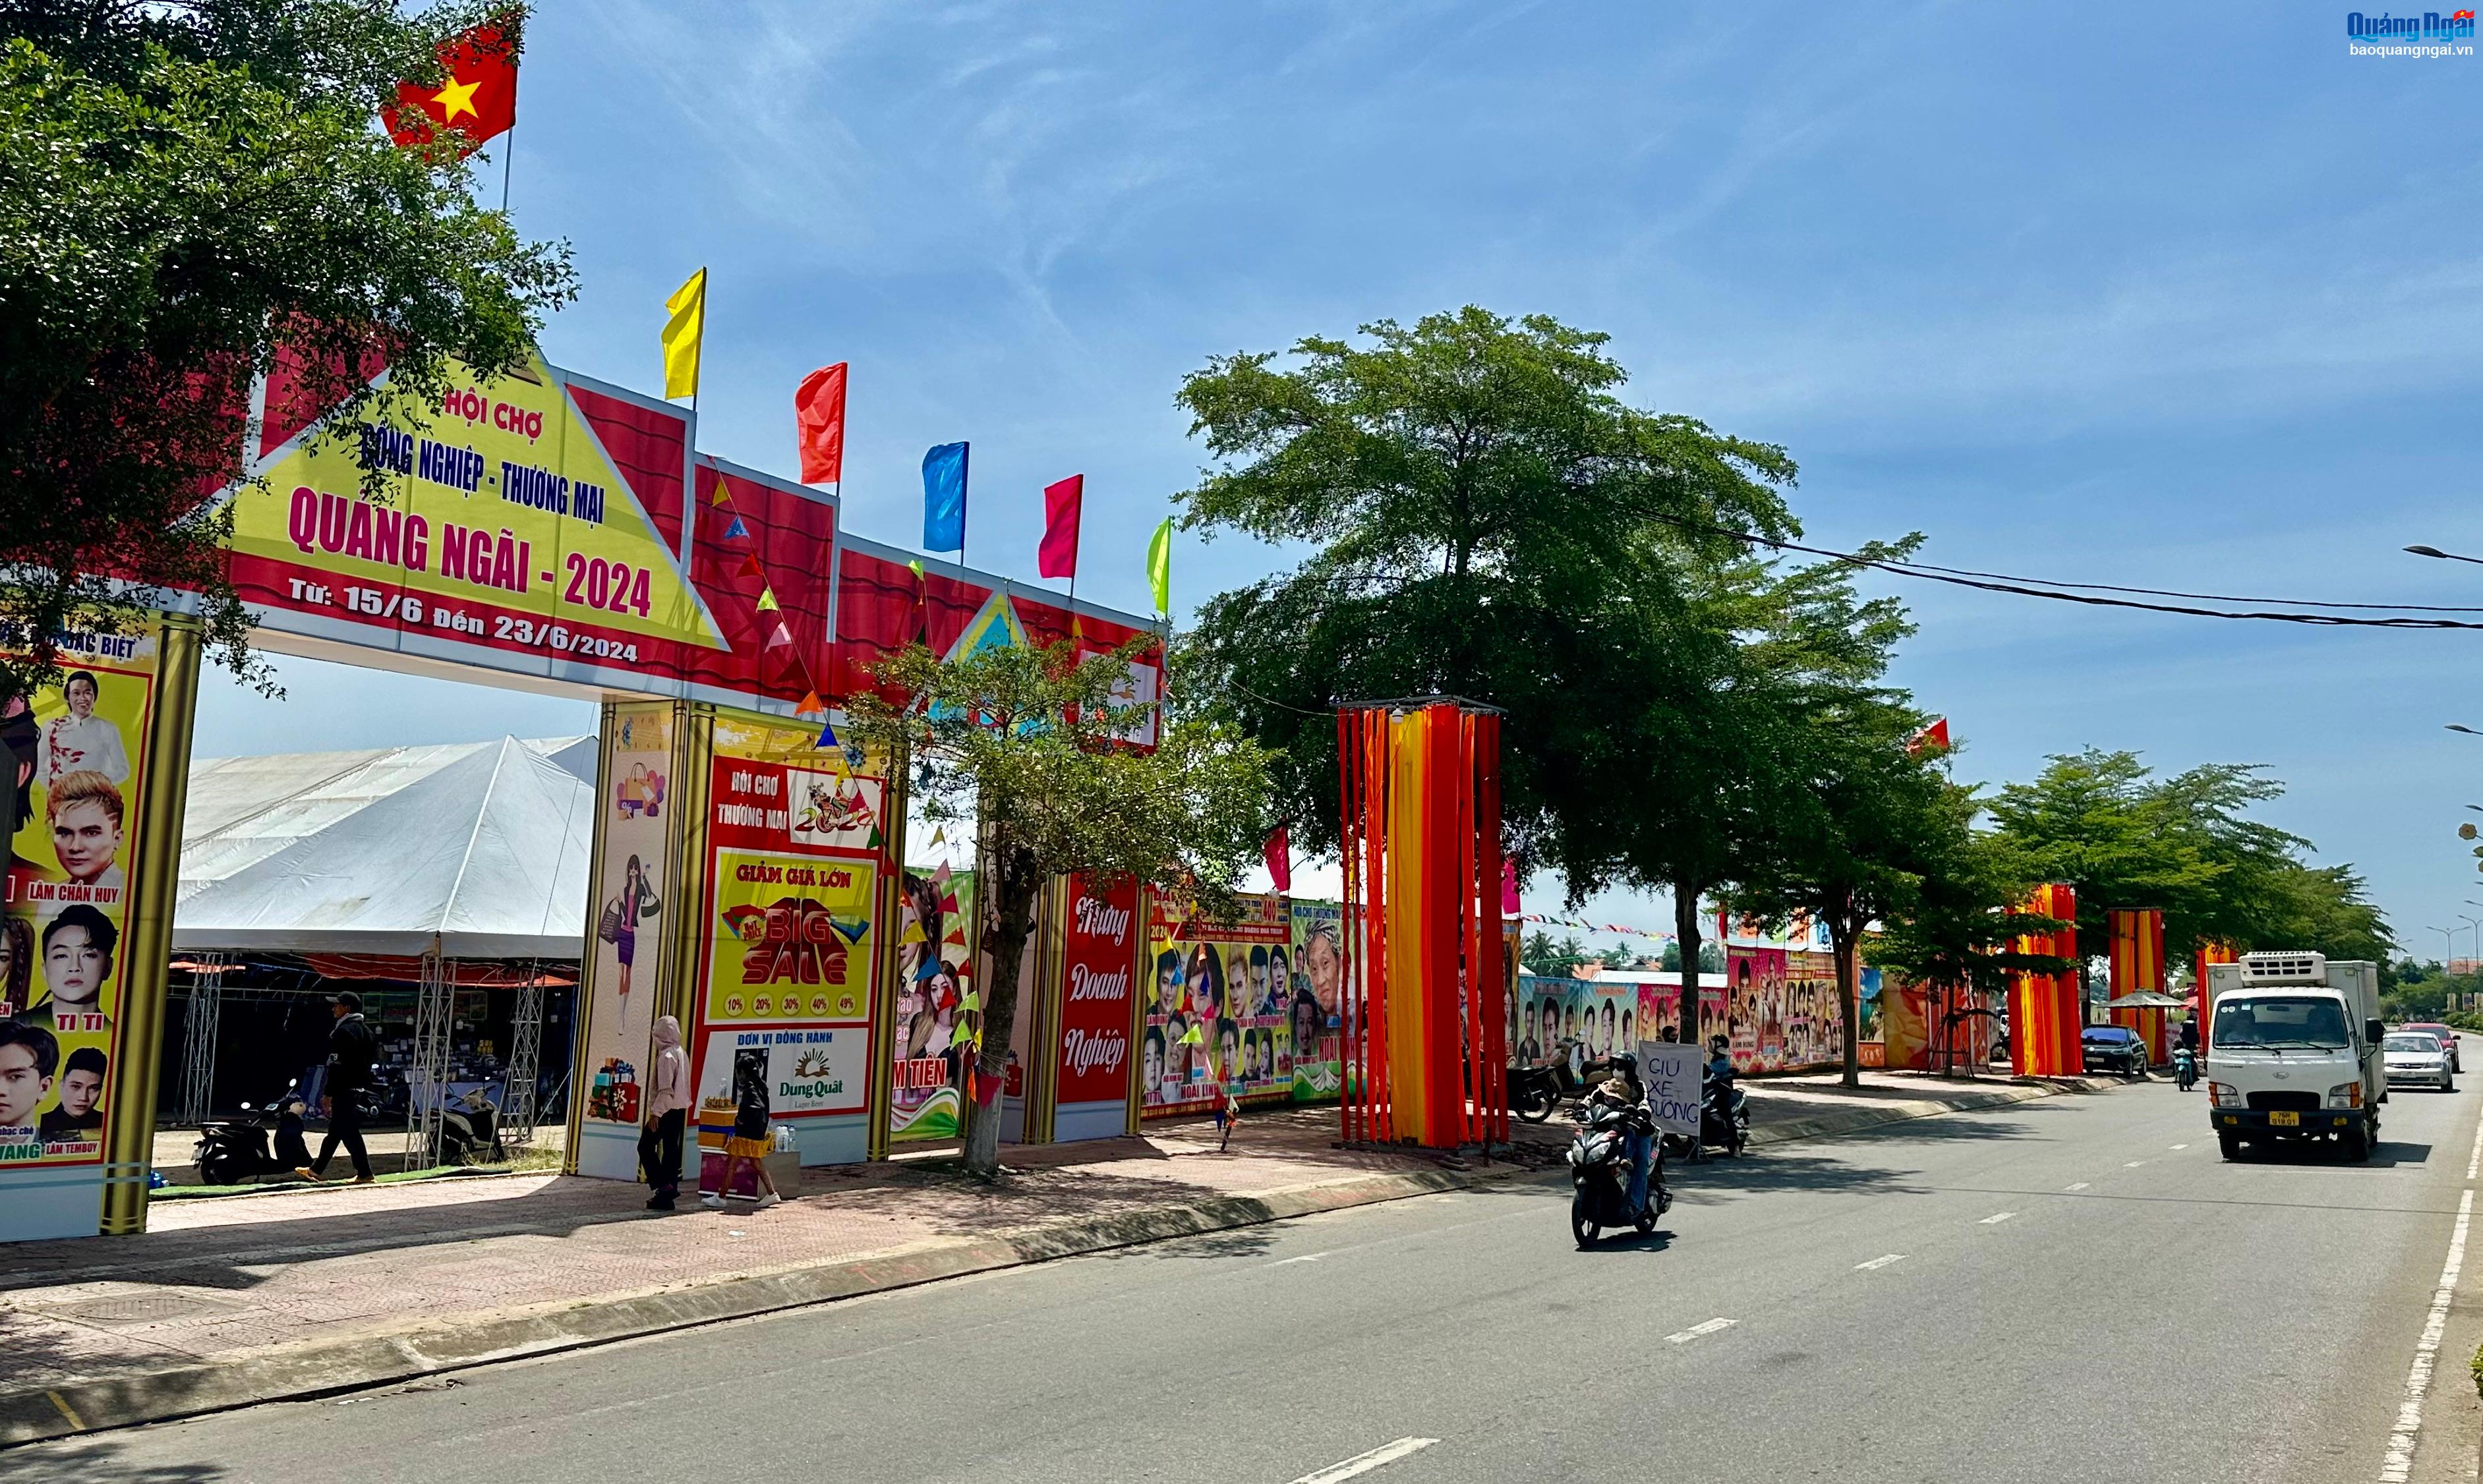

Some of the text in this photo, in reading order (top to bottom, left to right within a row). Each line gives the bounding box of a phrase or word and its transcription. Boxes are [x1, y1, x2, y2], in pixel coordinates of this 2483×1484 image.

[444, 387, 544, 445] HỘI CHỢ
[419, 438, 484, 498] NGHIỆP
[501, 461, 568, 515] THƯƠNG
[573, 480, 605, 529] MẠI
[288, 486, 429, 573] QUẢNG
[440, 523, 531, 594] NGÃI
[564, 552, 652, 619] 2024
[288, 577, 639, 663] Từ: 15/6 Đến 23/6/2024
[100, 635, 137, 661] BIỆT
[732, 770, 779, 800] HỘI CHỢ
[718, 803, 788, 834] THƯƠNG MẠI
[736, 861, 852, 888] GIẢM GIÁ LỚN
[30, 880, 55, 900] LÂM
[94, 888, 119, 903] HUY
[765, 907, 831, 944] BIG
[1262, 899, 1276, 922] 400
[742, 950, 848, 985] SALE
[1069, 963, 1128, 1002] Doanh
[728, 996, 854, 1011] 10% 20% 30% 40% 49%
[57, 1014, 103, 1031] TI TI
[738, 1029, 833, 1046] ĐƠN VỊ ĐỒNG HÀNH
[1065, 1028, 1126, 1077] Nghiệp
[910, 1056, 947, 1087] TIÊN
[780, 1082, 813, 1099] Dung
[1649, 1079, 1674, 1097] XE
[46, 1142, 98, 1155] LÂM TEMBOY
